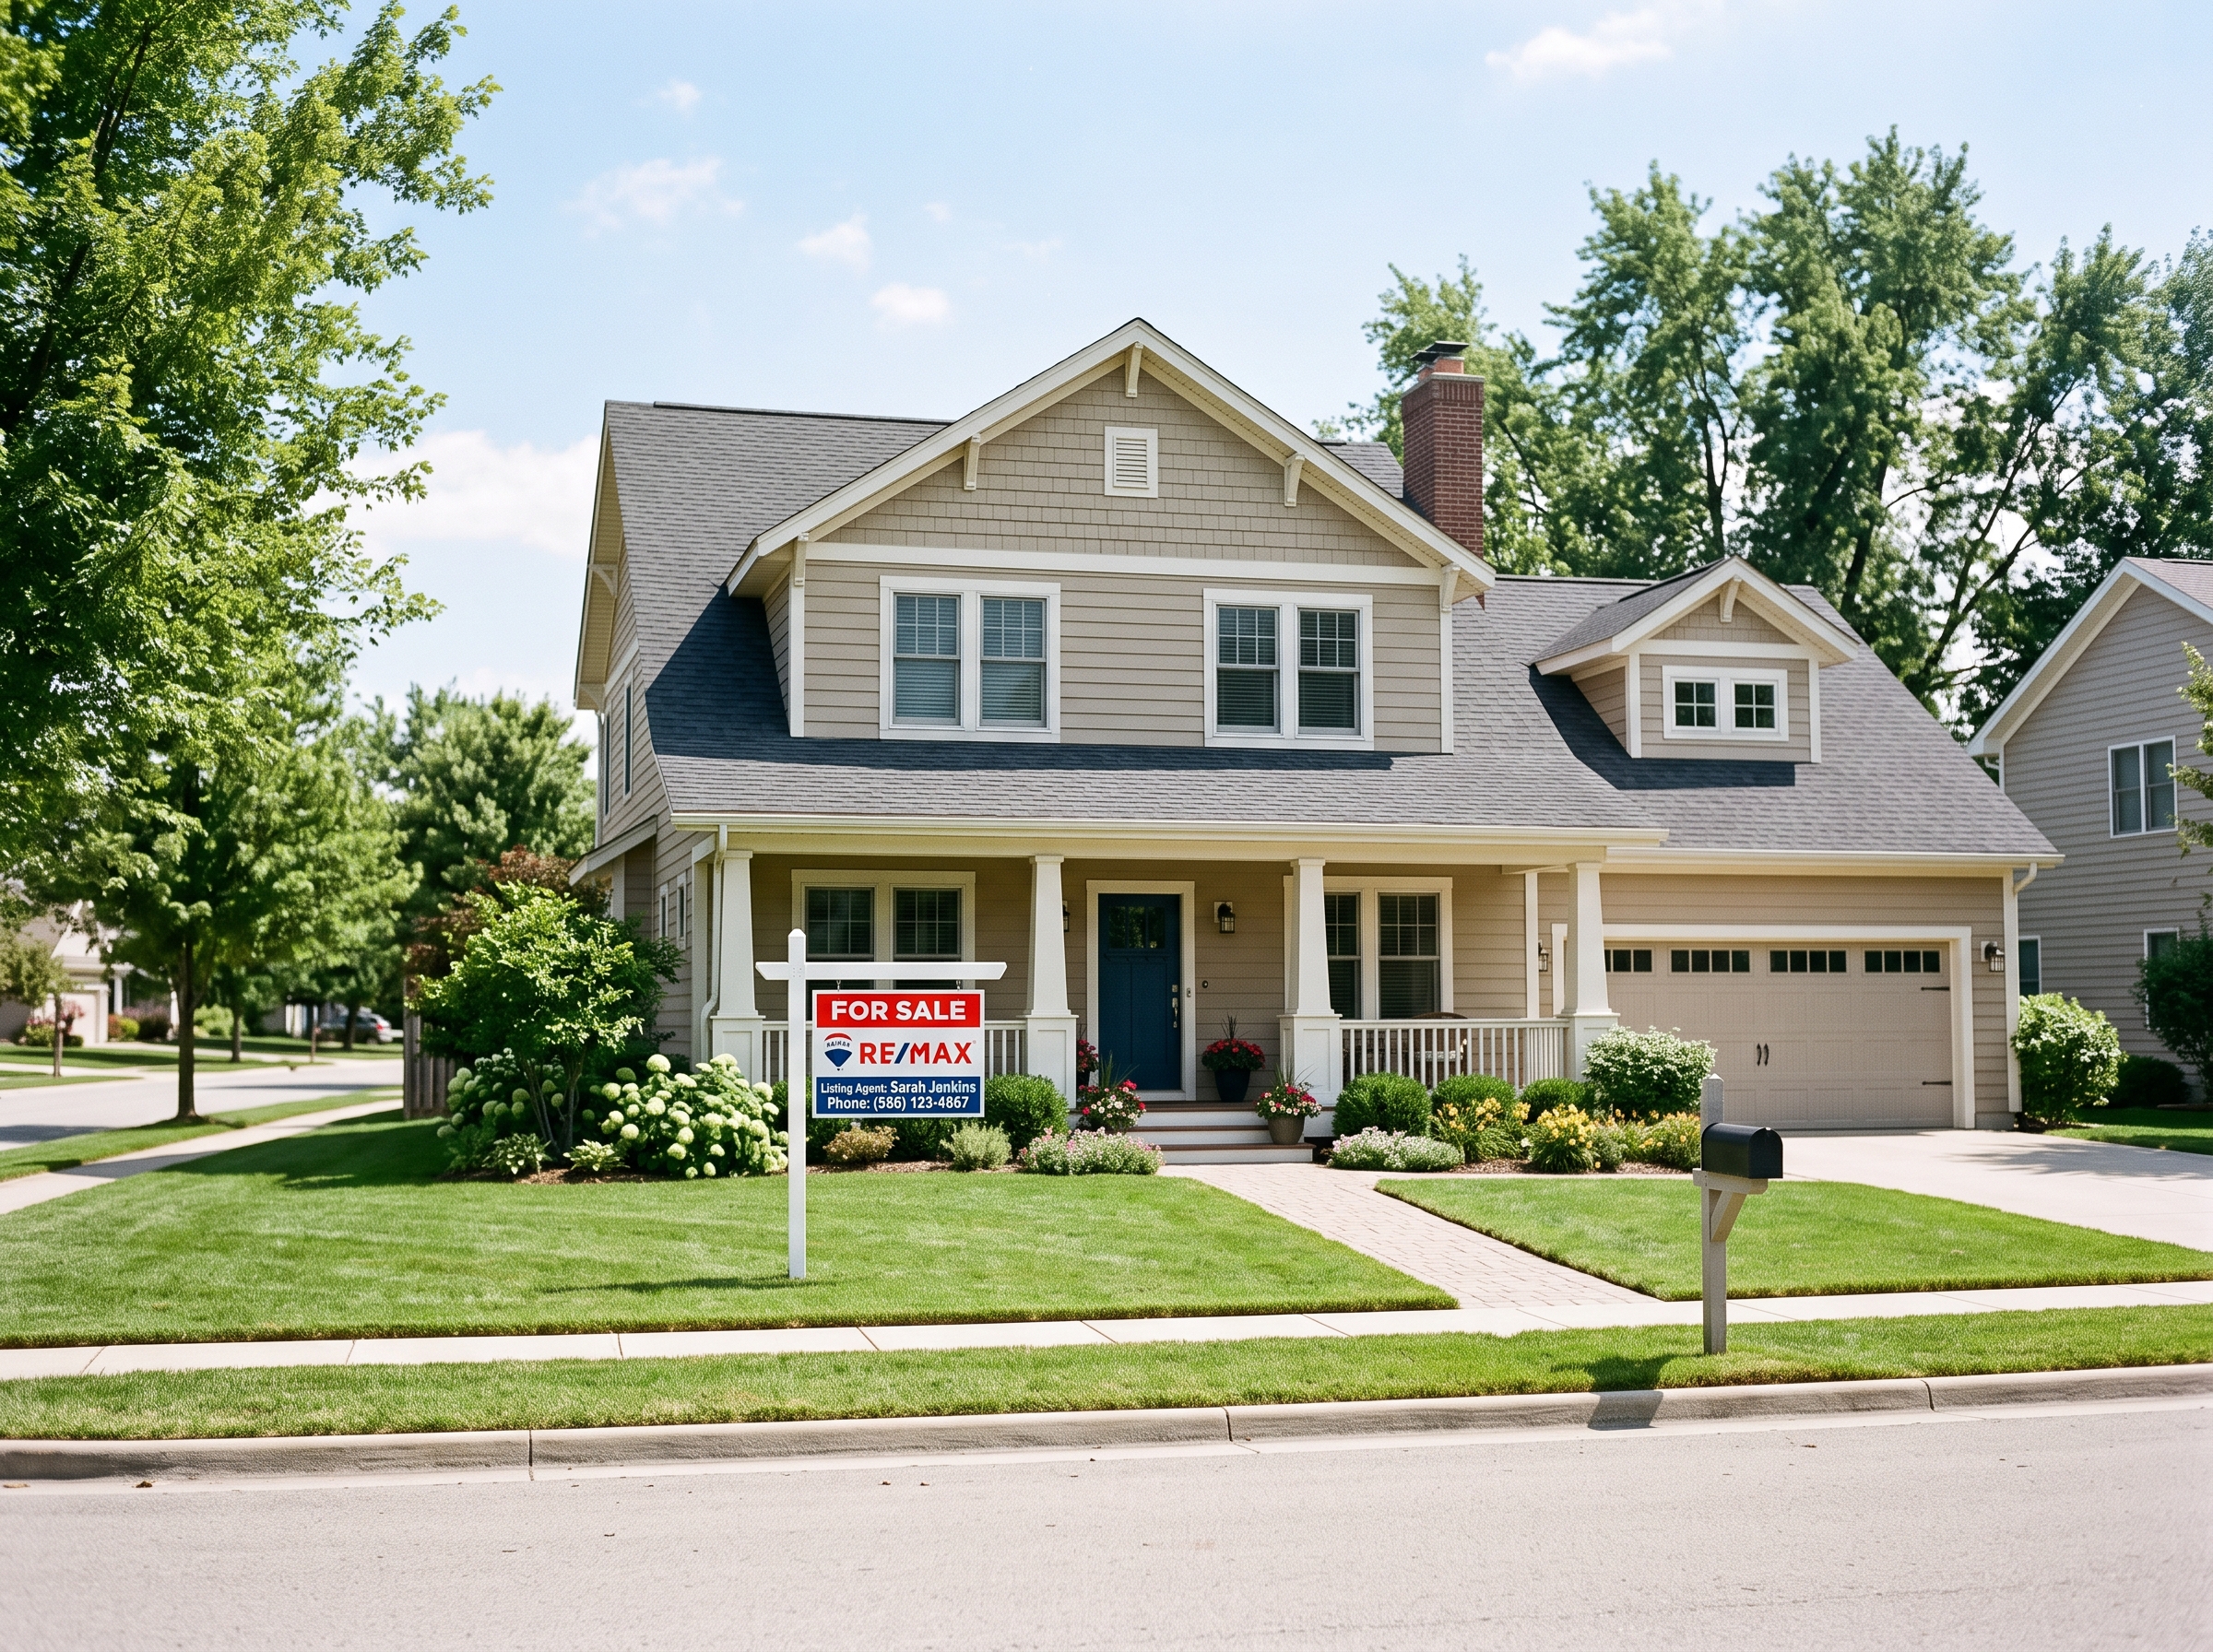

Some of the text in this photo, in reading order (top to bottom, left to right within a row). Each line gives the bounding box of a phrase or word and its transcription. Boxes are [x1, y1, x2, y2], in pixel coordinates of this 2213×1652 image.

[831, 1000, 966, 1021] FOR SALE
[859, 1042, 972, 1065] RE/MAX
[821, 1080, 976, 1095] Listing Agent: Sarah Jenkins
[827, 1096, 969, 1112] Phone: (586) 123-4867
